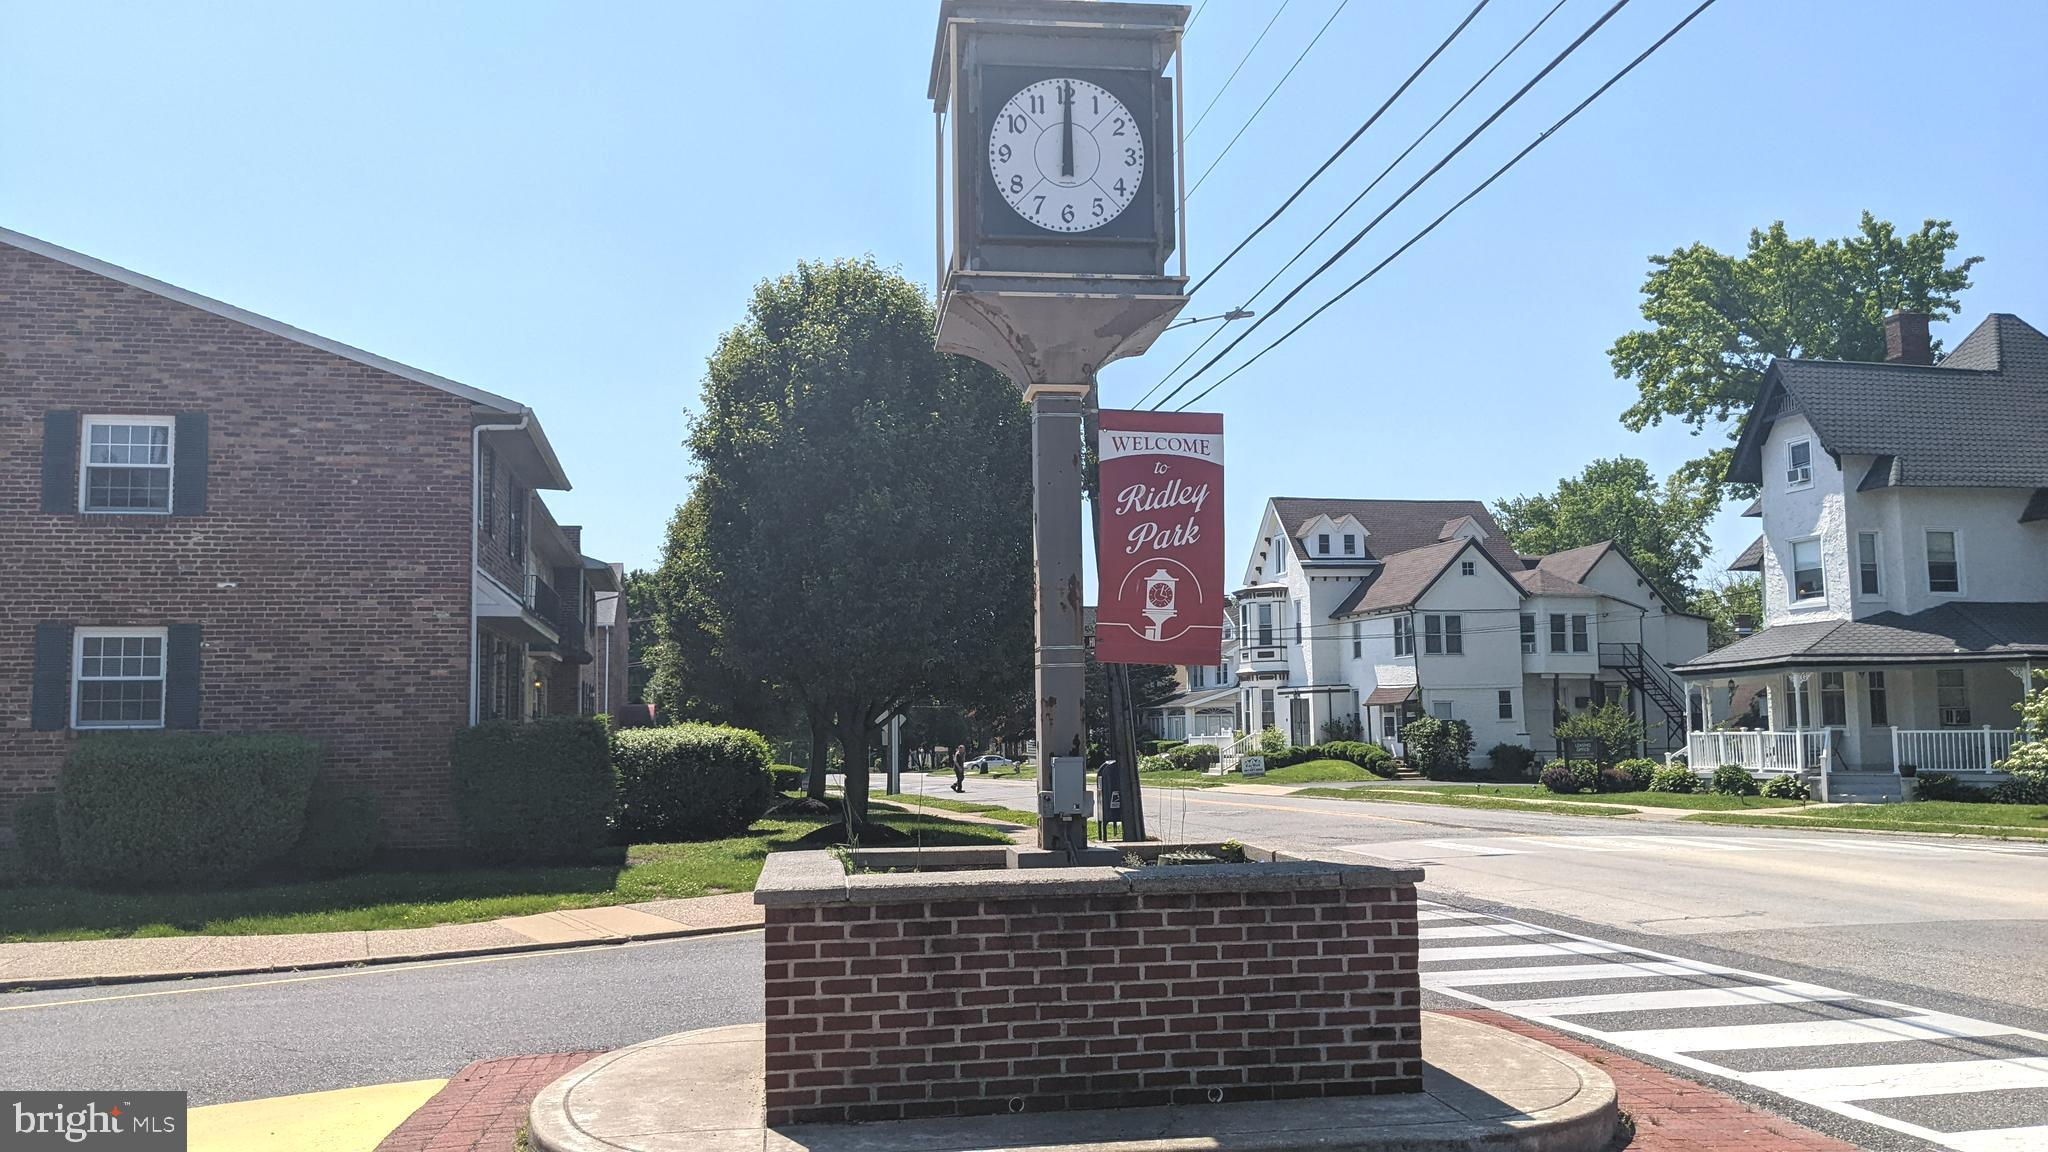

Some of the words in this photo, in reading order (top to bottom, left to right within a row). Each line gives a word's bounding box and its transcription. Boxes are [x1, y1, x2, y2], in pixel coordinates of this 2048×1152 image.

[1029, 95, 1045, 115] 11
[1092, 95, 1099, 115] 1
[1007, 114, 1027, 134] 10
[1112, 117, 1125, 136] 2
[998, 144, 1012, 163] 9
[1124, 148, 1137, 166] 3
[1010, 175, 1023, 194] 8
[1113, 177, 1126, 197] 4
[1033, 196, 1046, 215] 7
[1061, 204, 1074, 223] 6
[1092, 198, 1104, 217] 5
[1112, 436, 1211, 456] WELCOME
[1154, 461, 1170, 475] to
[1115, 479, 1210, 516] Ridley
[1126, 516, 1200, 554] Park
